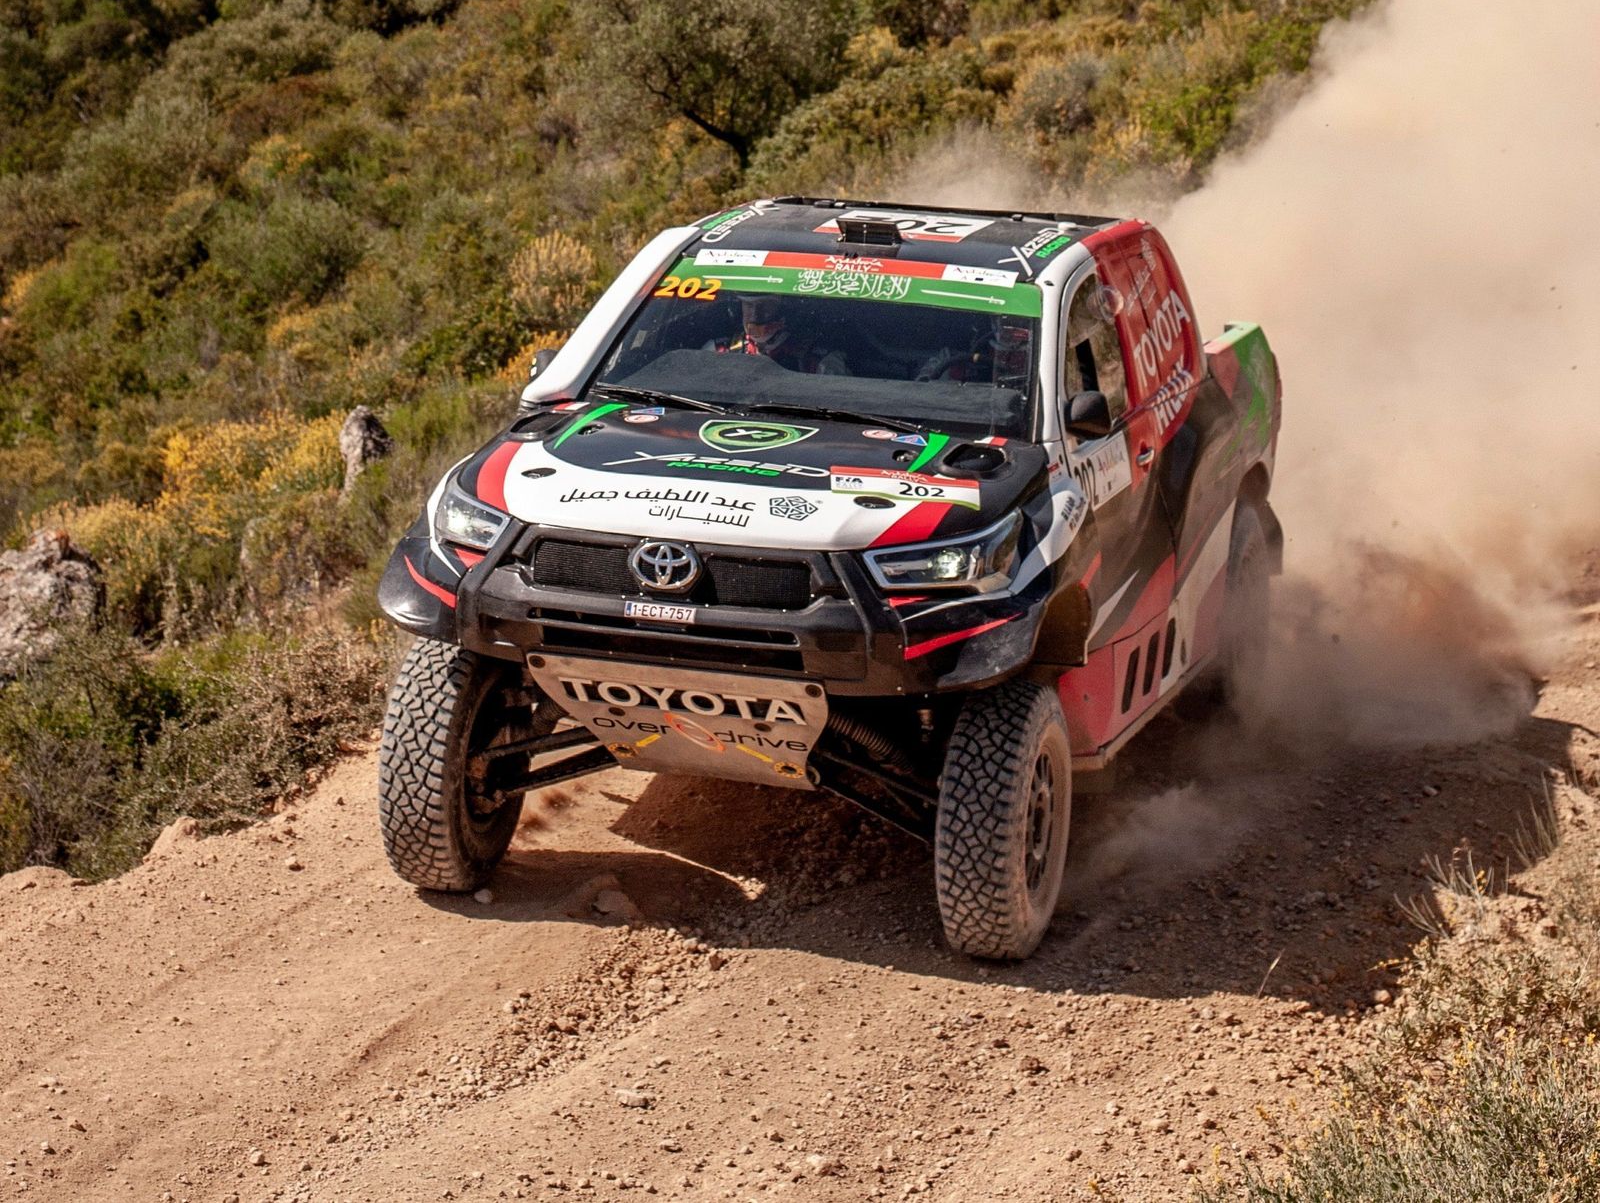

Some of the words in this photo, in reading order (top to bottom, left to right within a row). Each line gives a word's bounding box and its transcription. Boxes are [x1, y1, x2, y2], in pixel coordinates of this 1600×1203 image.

[835, 263, 872, 273] RALLY
[654, 276, 722, 300] 202
[1133, 289, 1190, 388] TOYOTA
[667, 461, 780, 476] RACING
[560, 488, 618, 503] جميل
[625, 488, 709, 503] اللطيف
[899, 482, 945, 497] 202
[711, 496, 756, 511] عبد
[633, 604, 692, 621] 1-ECT-757
[558, 676, 807, 726] TOYOTA
